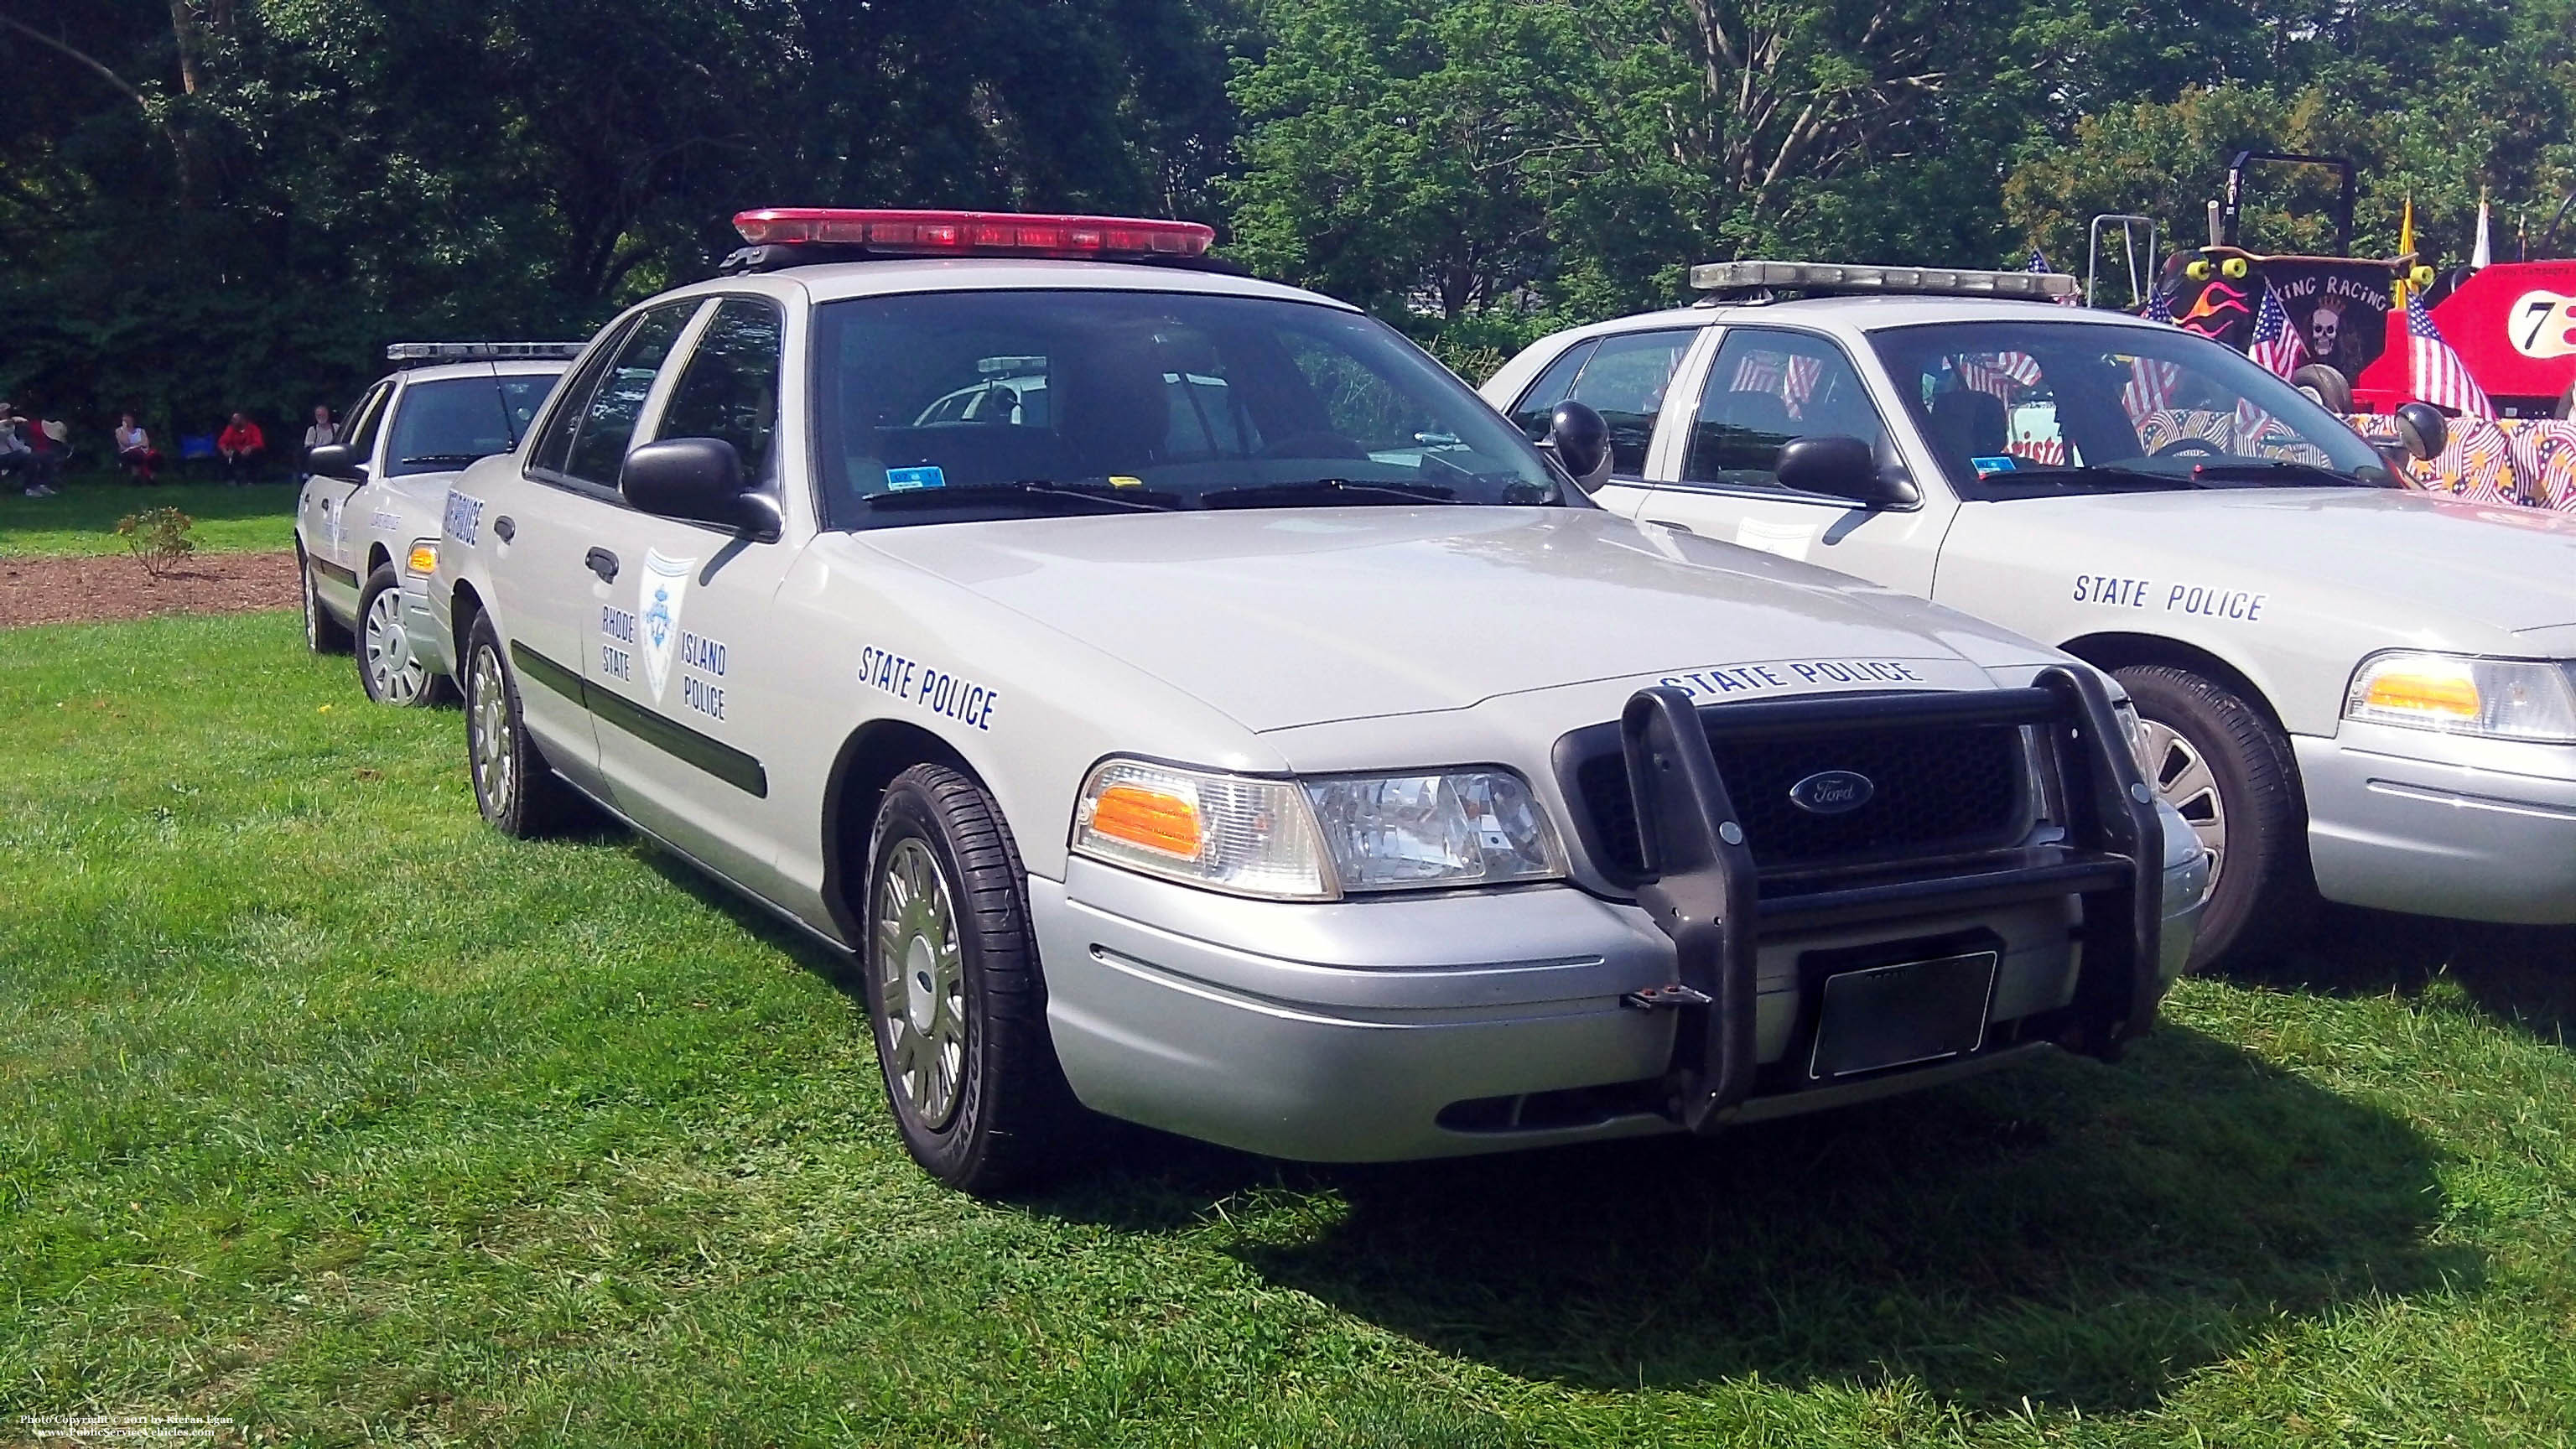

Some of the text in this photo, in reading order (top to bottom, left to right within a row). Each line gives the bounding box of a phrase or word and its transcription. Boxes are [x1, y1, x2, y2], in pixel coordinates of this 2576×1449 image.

[2073, 574, 2267, 621] STATE POLICE
[602, 605, 726, 677] RHODE ISLAND
[602, 645, 725, 721] STATE POLICE
[858, 646, 998, 731] STATE POLICE
[1659, 662, 1924, 699] STATE POLICE
[1814, 779, 1855, 803] Ford
